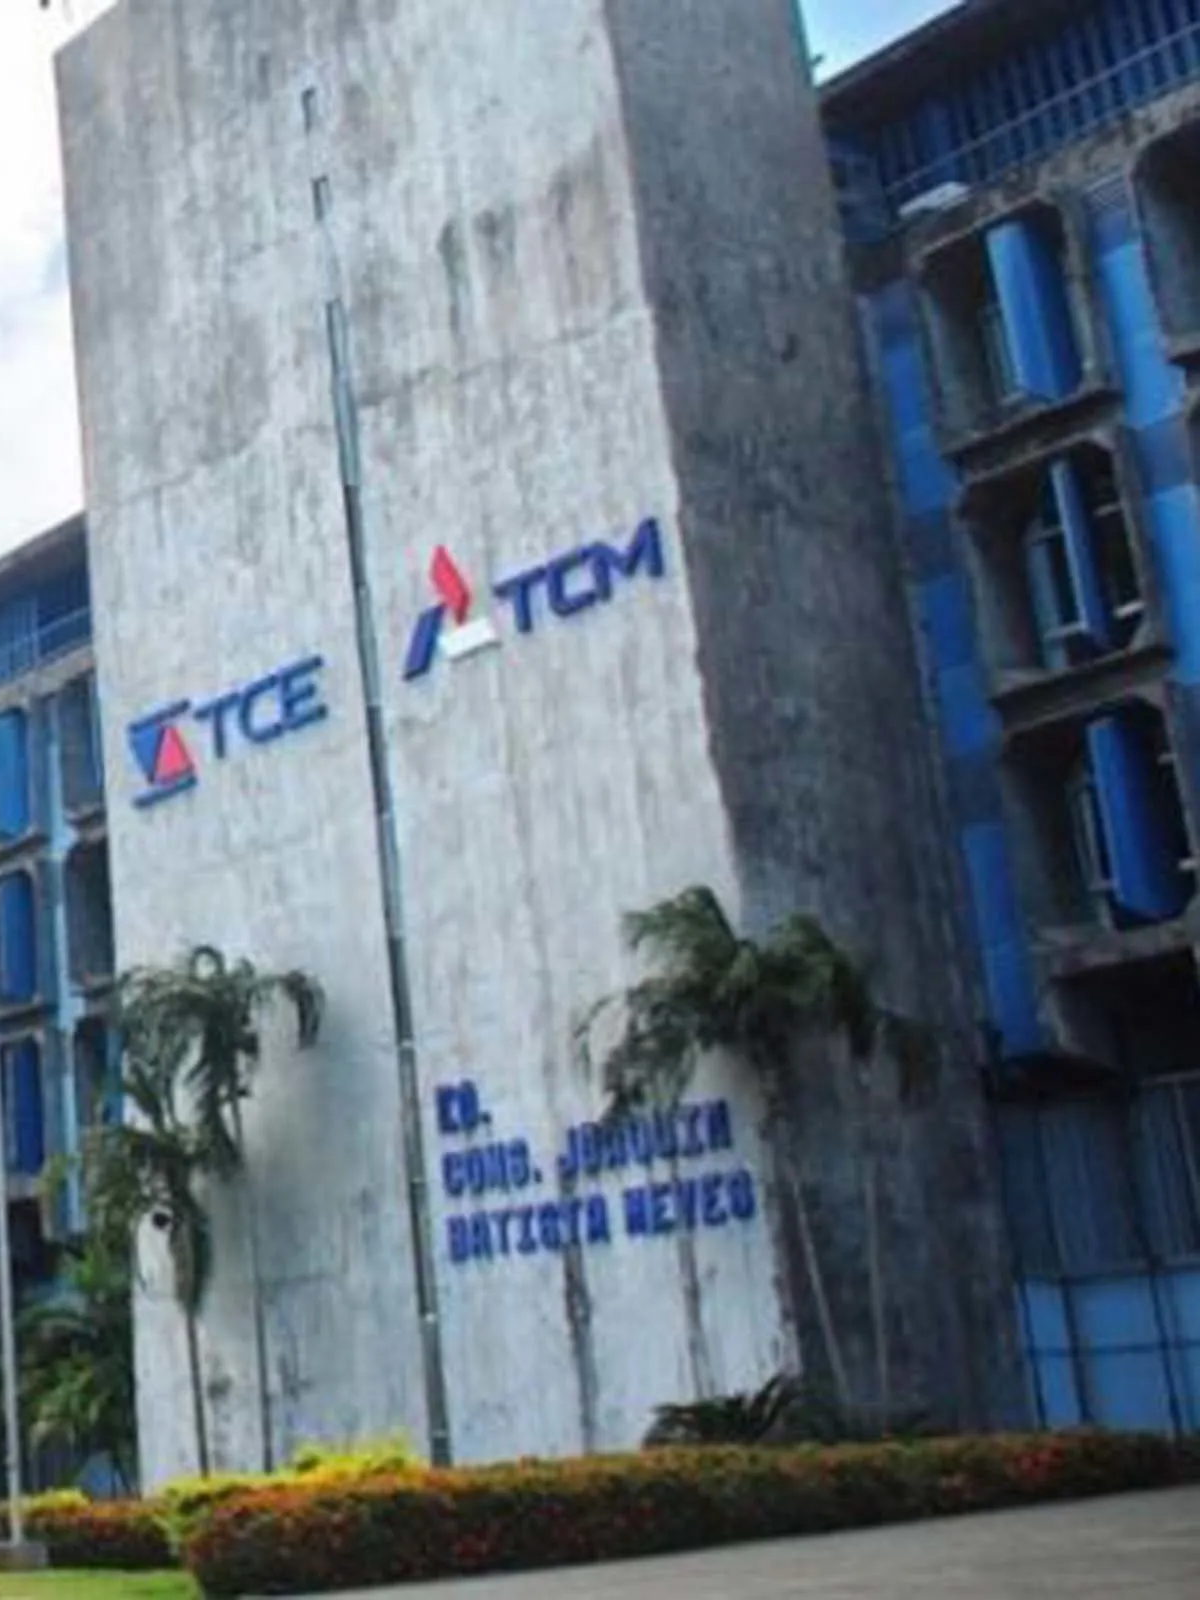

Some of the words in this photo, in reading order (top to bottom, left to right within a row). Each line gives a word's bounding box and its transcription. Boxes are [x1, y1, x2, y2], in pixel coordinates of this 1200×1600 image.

[493, 516, 664, 634] TCM
[193, 655, 328, 760] TCE
[447, 1187, 611, 1263] BATISTA
[623, 1167, 757, 1237] NEVES
